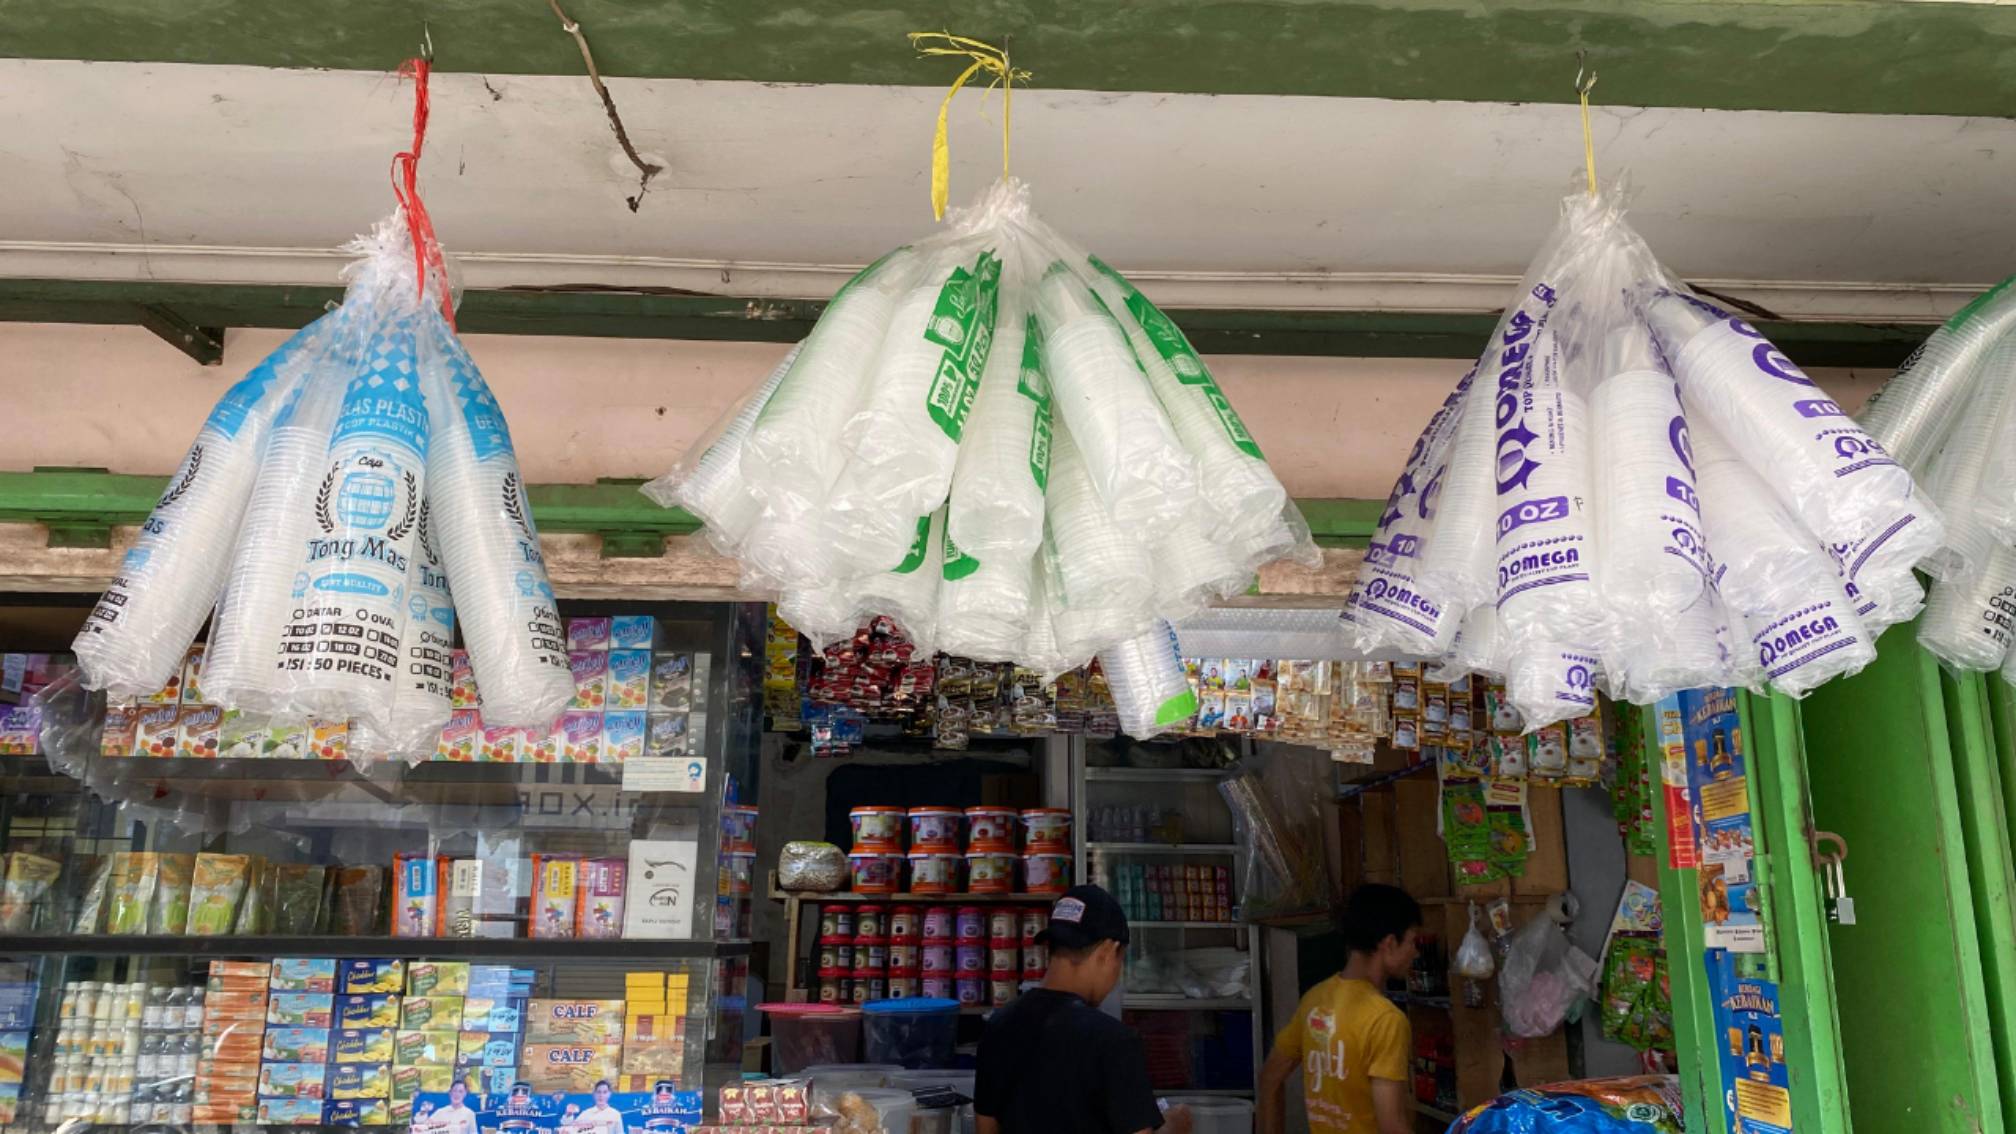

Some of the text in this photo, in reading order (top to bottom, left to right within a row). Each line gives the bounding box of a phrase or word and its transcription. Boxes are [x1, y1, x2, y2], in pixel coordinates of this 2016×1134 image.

[1519, 501, 1560, 521] OZ
[307, 535, 407, 573] Tong Mas
[1397, 537, 1416, 552] 10
[1509, 547, 1580, 576] OMEGA
[306, 607, 396, 630] DATAR OVAL
[348, 626, 361, 636] OZ
[1774, 615, 1840, 653] OMEGA
[345, 644, 357, 654] OZ
[314, 658, 333, 671] 50
[337, 659, 383, 681] PIECES
[553, 1005, 597, 1019] CALF
[549, 1050, 594, 1064] CALF
